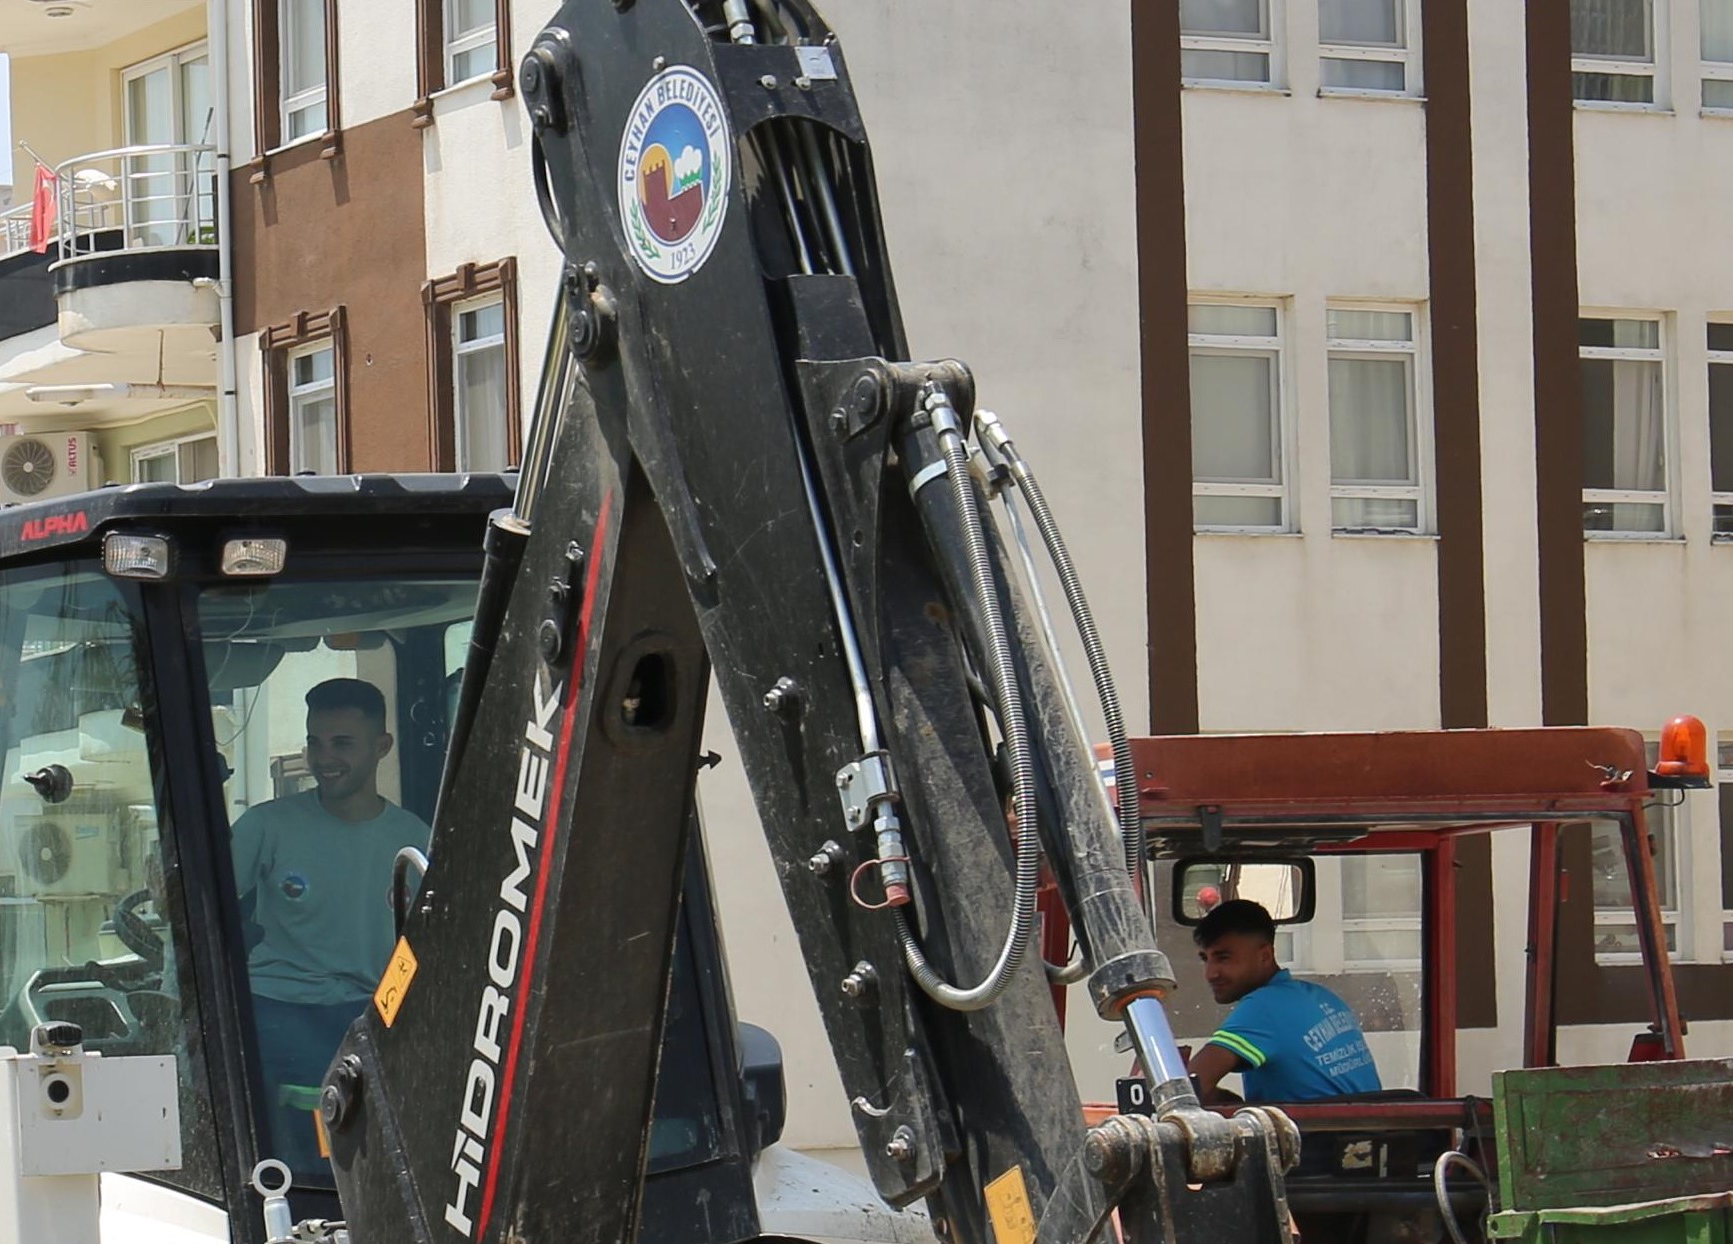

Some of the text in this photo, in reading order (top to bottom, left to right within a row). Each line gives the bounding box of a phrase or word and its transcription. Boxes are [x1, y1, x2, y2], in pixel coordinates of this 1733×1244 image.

[624, 78, 721, 182] CEYHAN BELEDİYESİ
[670, 243, 696, 270] 1923
[68, 437, 78, 468] ALTUS
[20, 510, 88, 541] ALPHA
